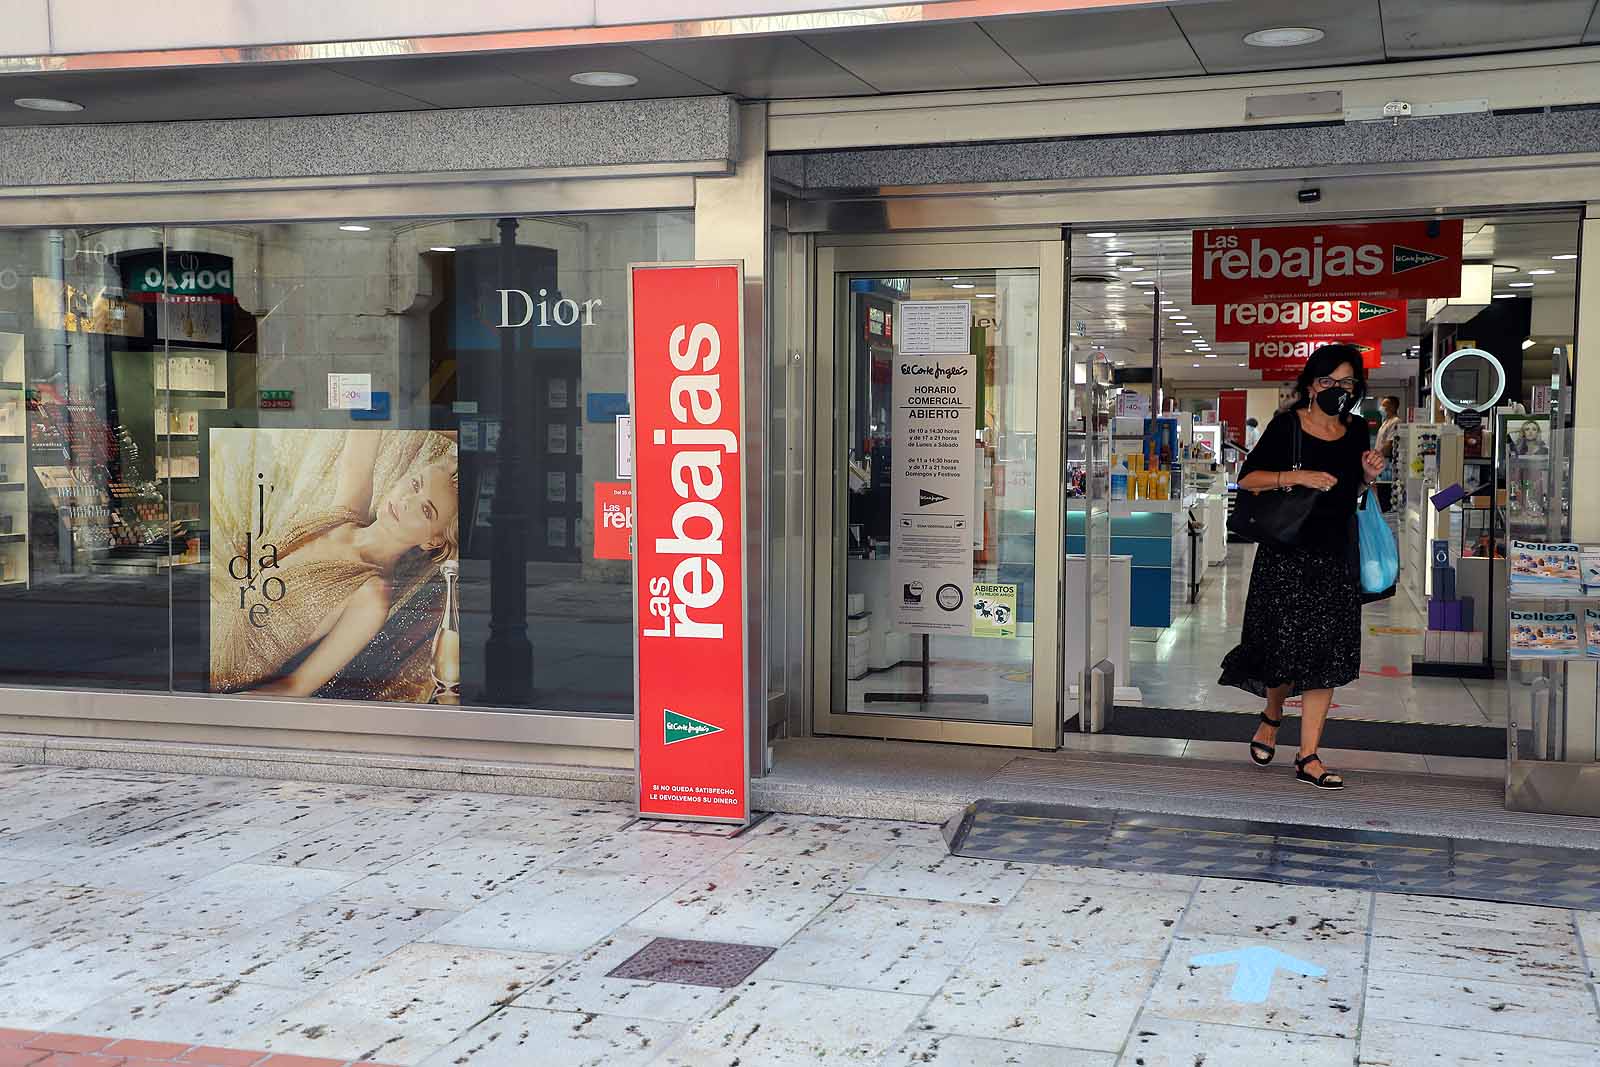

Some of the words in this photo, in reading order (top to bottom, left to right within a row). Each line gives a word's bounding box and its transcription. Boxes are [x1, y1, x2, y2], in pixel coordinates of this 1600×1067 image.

[1203, 232, 1238, 249] Las
[1203, 235, 1384, 287] rebajas
[496, 288, 602, 327] Dior
[1223, 300, 1352, 330] rebajas
[1254, 340, 1342, 361] rebaj
[914, 386, 956, 394] HORARIO
[908, 397, 963, 405] COMERCIAL
[909, 409, 959, 419] ABIERTO
[654, 323, 737, 639] rebajas
[603, 502, 620, 511] Las
[1514, 541, 1578, 552] belleza
[644, 576, 670, 637] Las
[1511, 612, 1576, 621] belleza
[695, 787, 734, 795] SATISFECHO
[659, 794, 701, 802] DEVOLVEMOS
